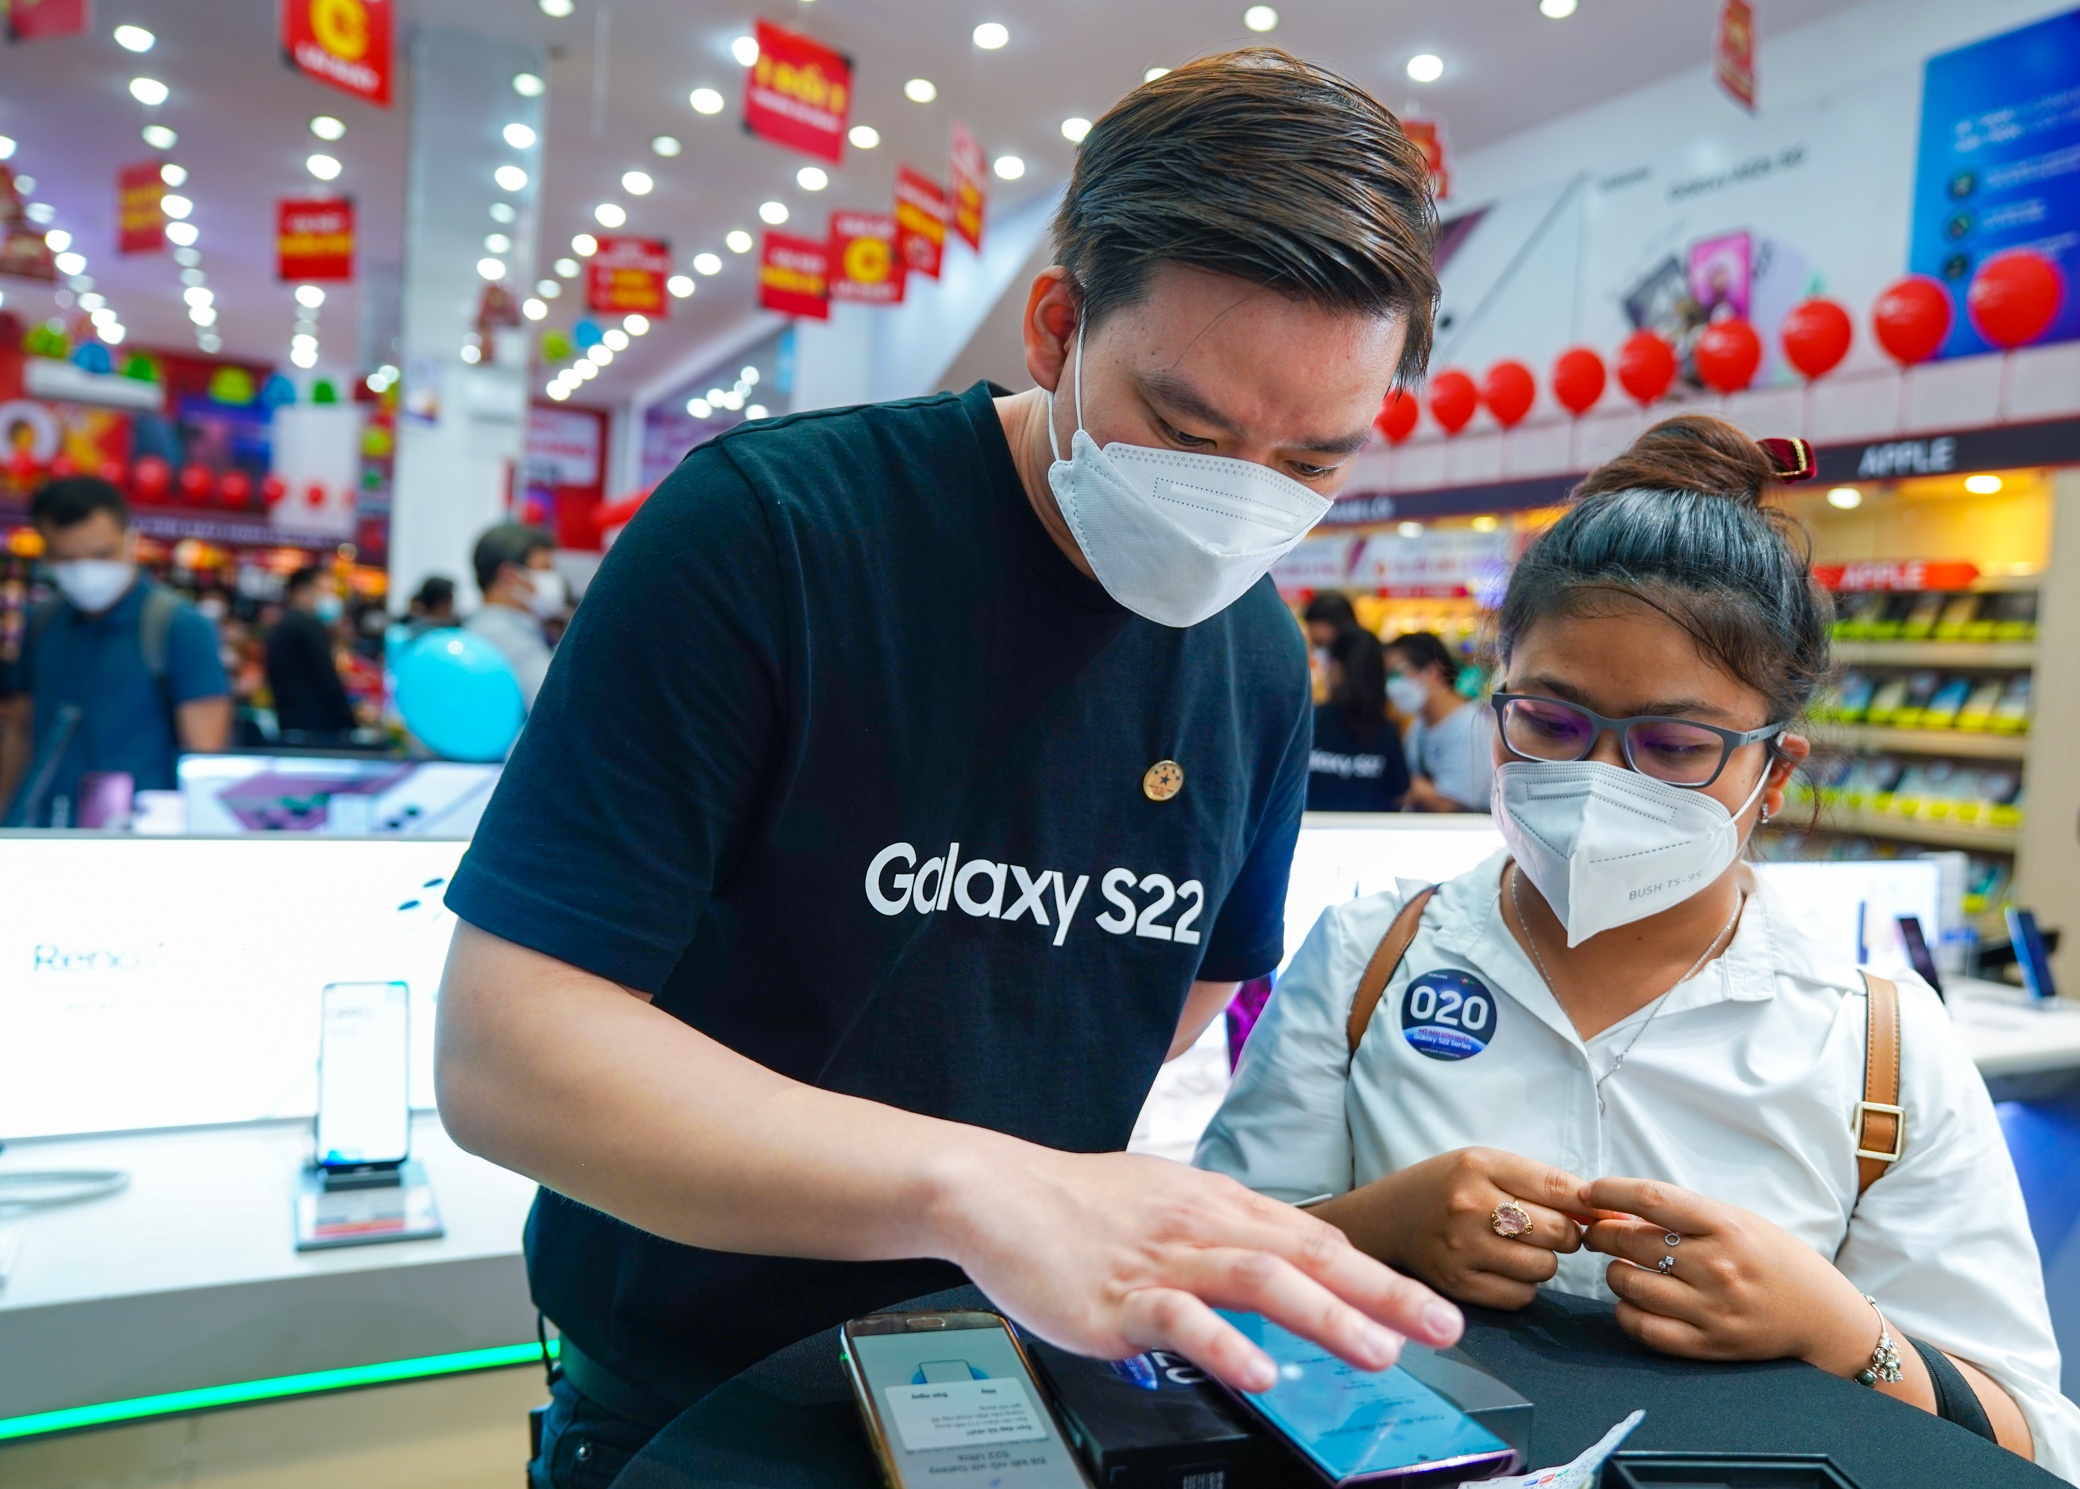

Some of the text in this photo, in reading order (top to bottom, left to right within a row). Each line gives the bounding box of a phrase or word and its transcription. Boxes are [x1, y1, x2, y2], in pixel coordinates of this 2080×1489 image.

[1857, 436, 1957, 479] APPLE
[1839, 560, 1926, 592] APPLE
[865, 842, 1205, 947] Galaxy S22
[1628, 870, 1703, 901] BUSH TS-95
[33, 943, 140, 972] Reno
[1410, 985, 1488, 1031] 020
[1413, 1034, 1437, 1044] Galaxy
[1438, 1037, 1450, 1046] S22
[1451, 1040, 1472, 1051] Series
